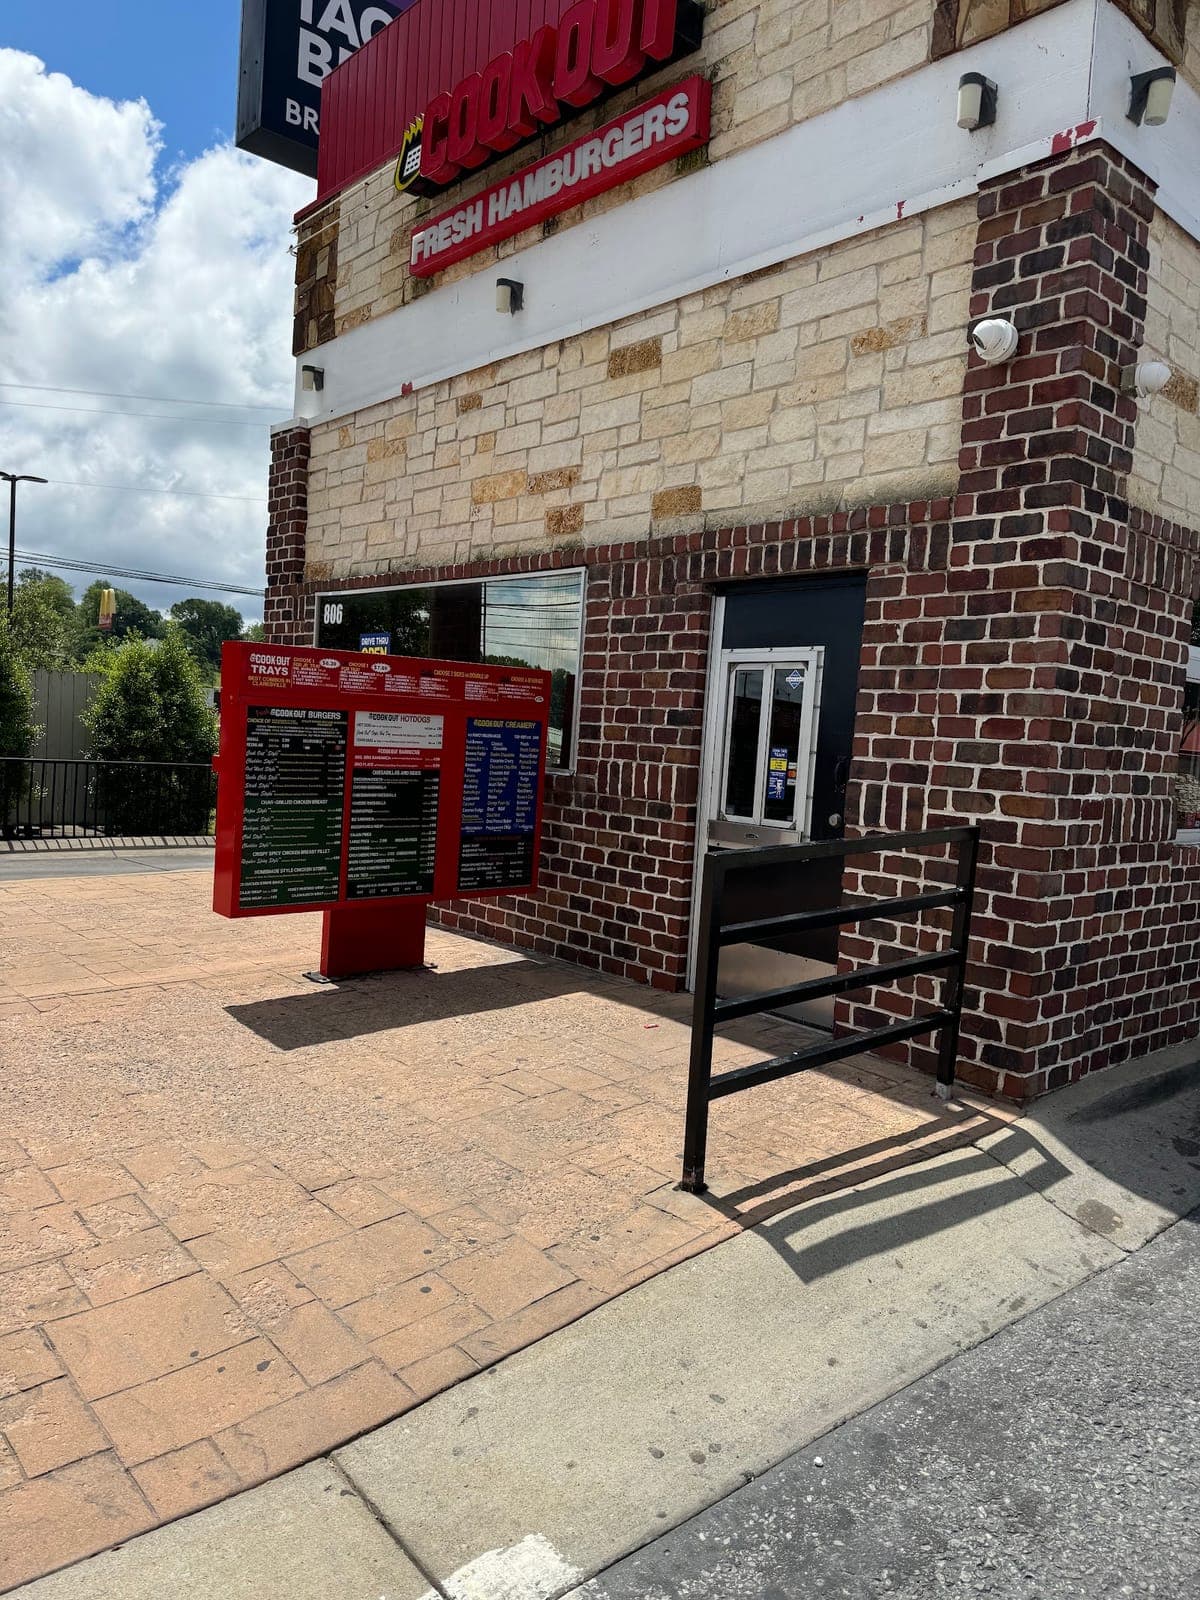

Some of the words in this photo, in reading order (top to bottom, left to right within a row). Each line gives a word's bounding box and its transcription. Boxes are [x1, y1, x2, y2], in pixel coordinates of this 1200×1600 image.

[420, 24, 557, 184] COOK
[411, 200, 482, 265] FRESH
[488, 92, 690, 227] HAMBURGERS
[323, 603, 344, 624] 806
[361, 638, 375, 646] DRIVE
[376, 637, 389, 645] THRU
[251, 664, 289, 676] TRAYS
[308, 711, 342, 720] BURGERS
[400, 715, 431, 723] HOTDOGS
[505, 721, 537, 729] CREAMERY
